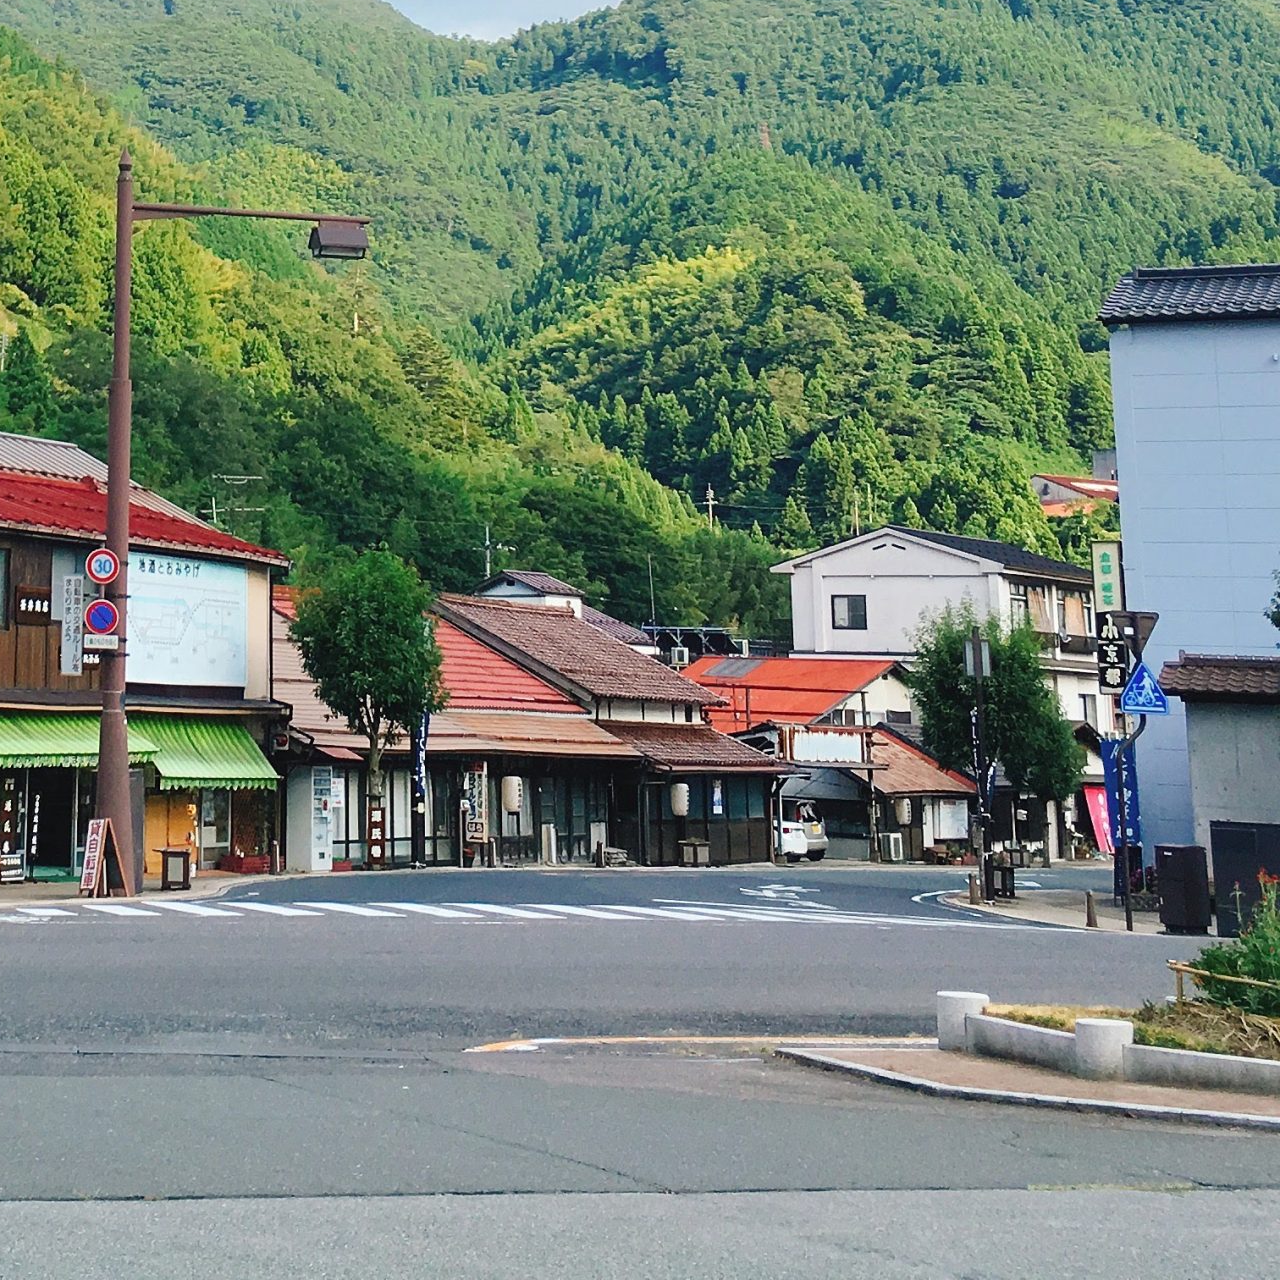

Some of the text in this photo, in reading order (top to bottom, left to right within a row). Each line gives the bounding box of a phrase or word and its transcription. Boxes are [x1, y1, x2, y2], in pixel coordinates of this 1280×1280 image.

[94, 559, 112, 574] 30
[139, 558, 201, 578] 地酒とおみやげ
[64, 578, 73, 641] まもりましょう
[72, 578, 82, 673] 自転車の交通ルールを
[1101, 613, 1121, 686] 小京都
[83, 821, 101, 888] 貸自転車
